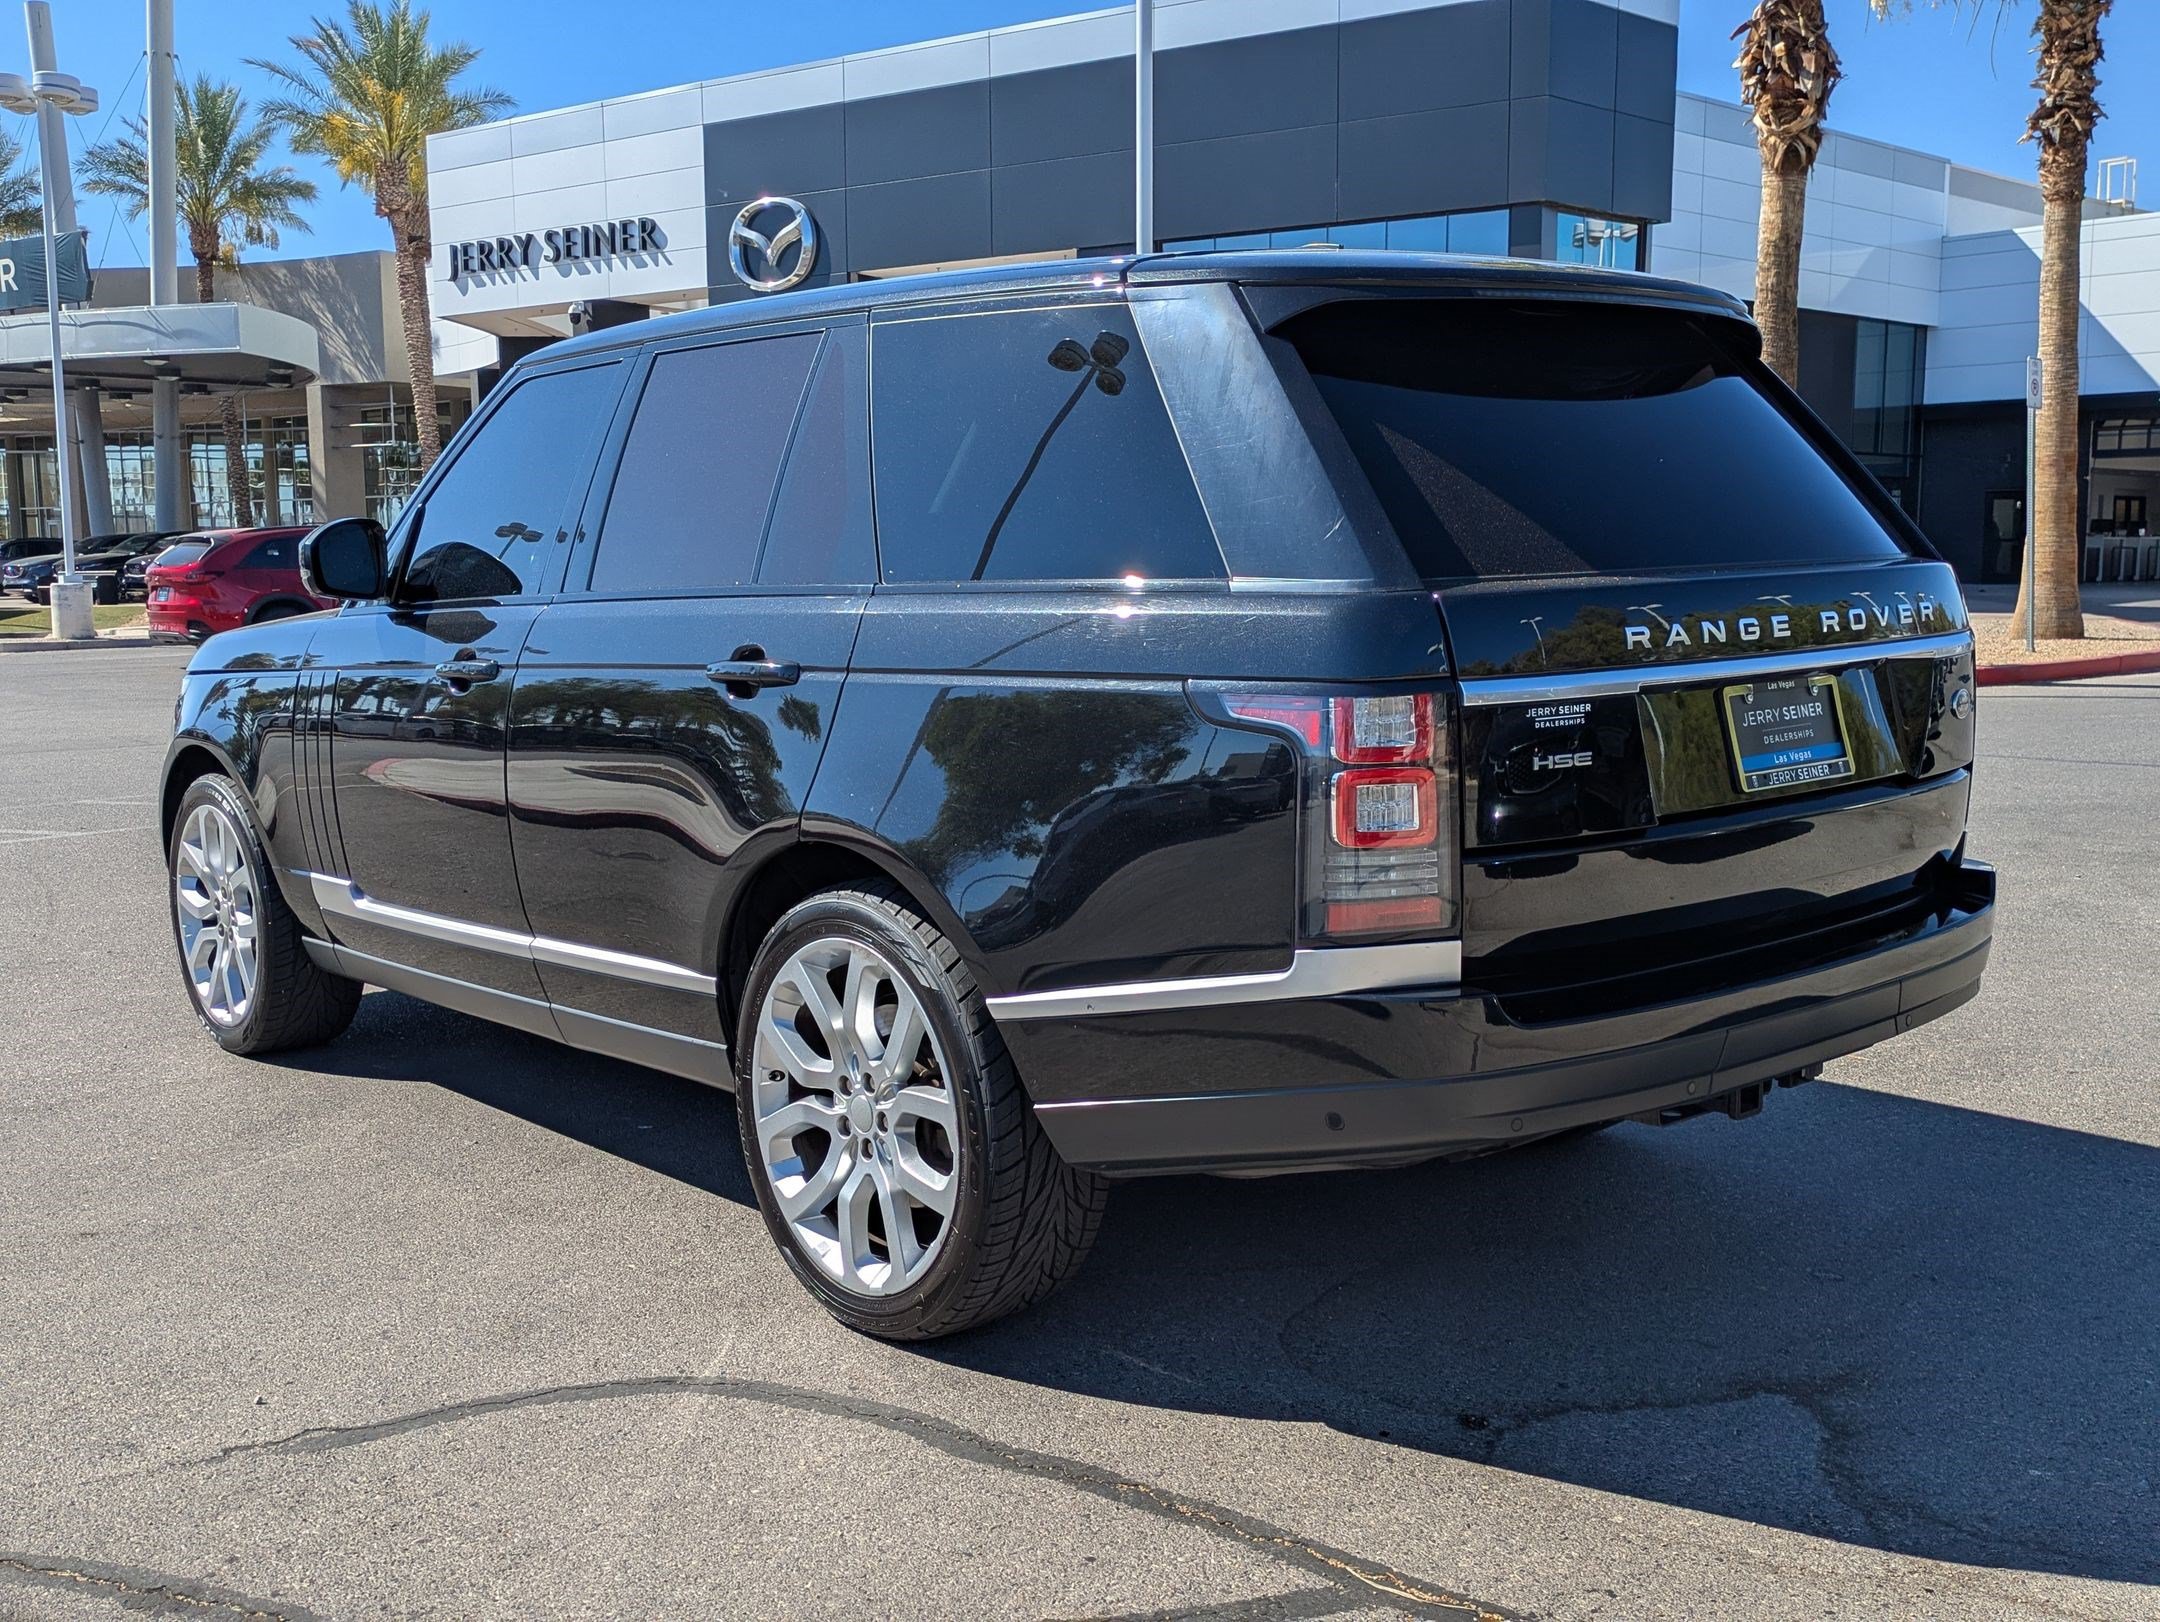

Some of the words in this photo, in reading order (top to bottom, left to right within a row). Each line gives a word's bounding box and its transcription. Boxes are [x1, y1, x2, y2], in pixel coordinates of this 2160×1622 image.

[448, 233, 534, 283] JERRY
[543, 216, 663, 264] SEINER
[1624, 614, 1792, 650] RANGE
[1819, 601, 1935, 634] ROVER
[1767, 682, 1778, 690] Las
[1778, 680, 1795, 690] Vegas
[1526, 706, 1557, 718] JERRY
[1558, 703, 1592, 715] SEINER
[1742, 707, 1781, 727] JERRY
[1782, 702, 1823, 720] SEINER
[1535, 717, 1586, 729] DEALERSHIPS
[1763, 728, 1814, 745] DEALERSHIPS
[1533, 751, 1593, 771] HSE
[1773, 753, 1788, 764] Las
[1789, 750, 1812, 762] Vegas
[1768, 768, 1798, 785] JERRY
[1797, 764, 1830, 780] SEINER
